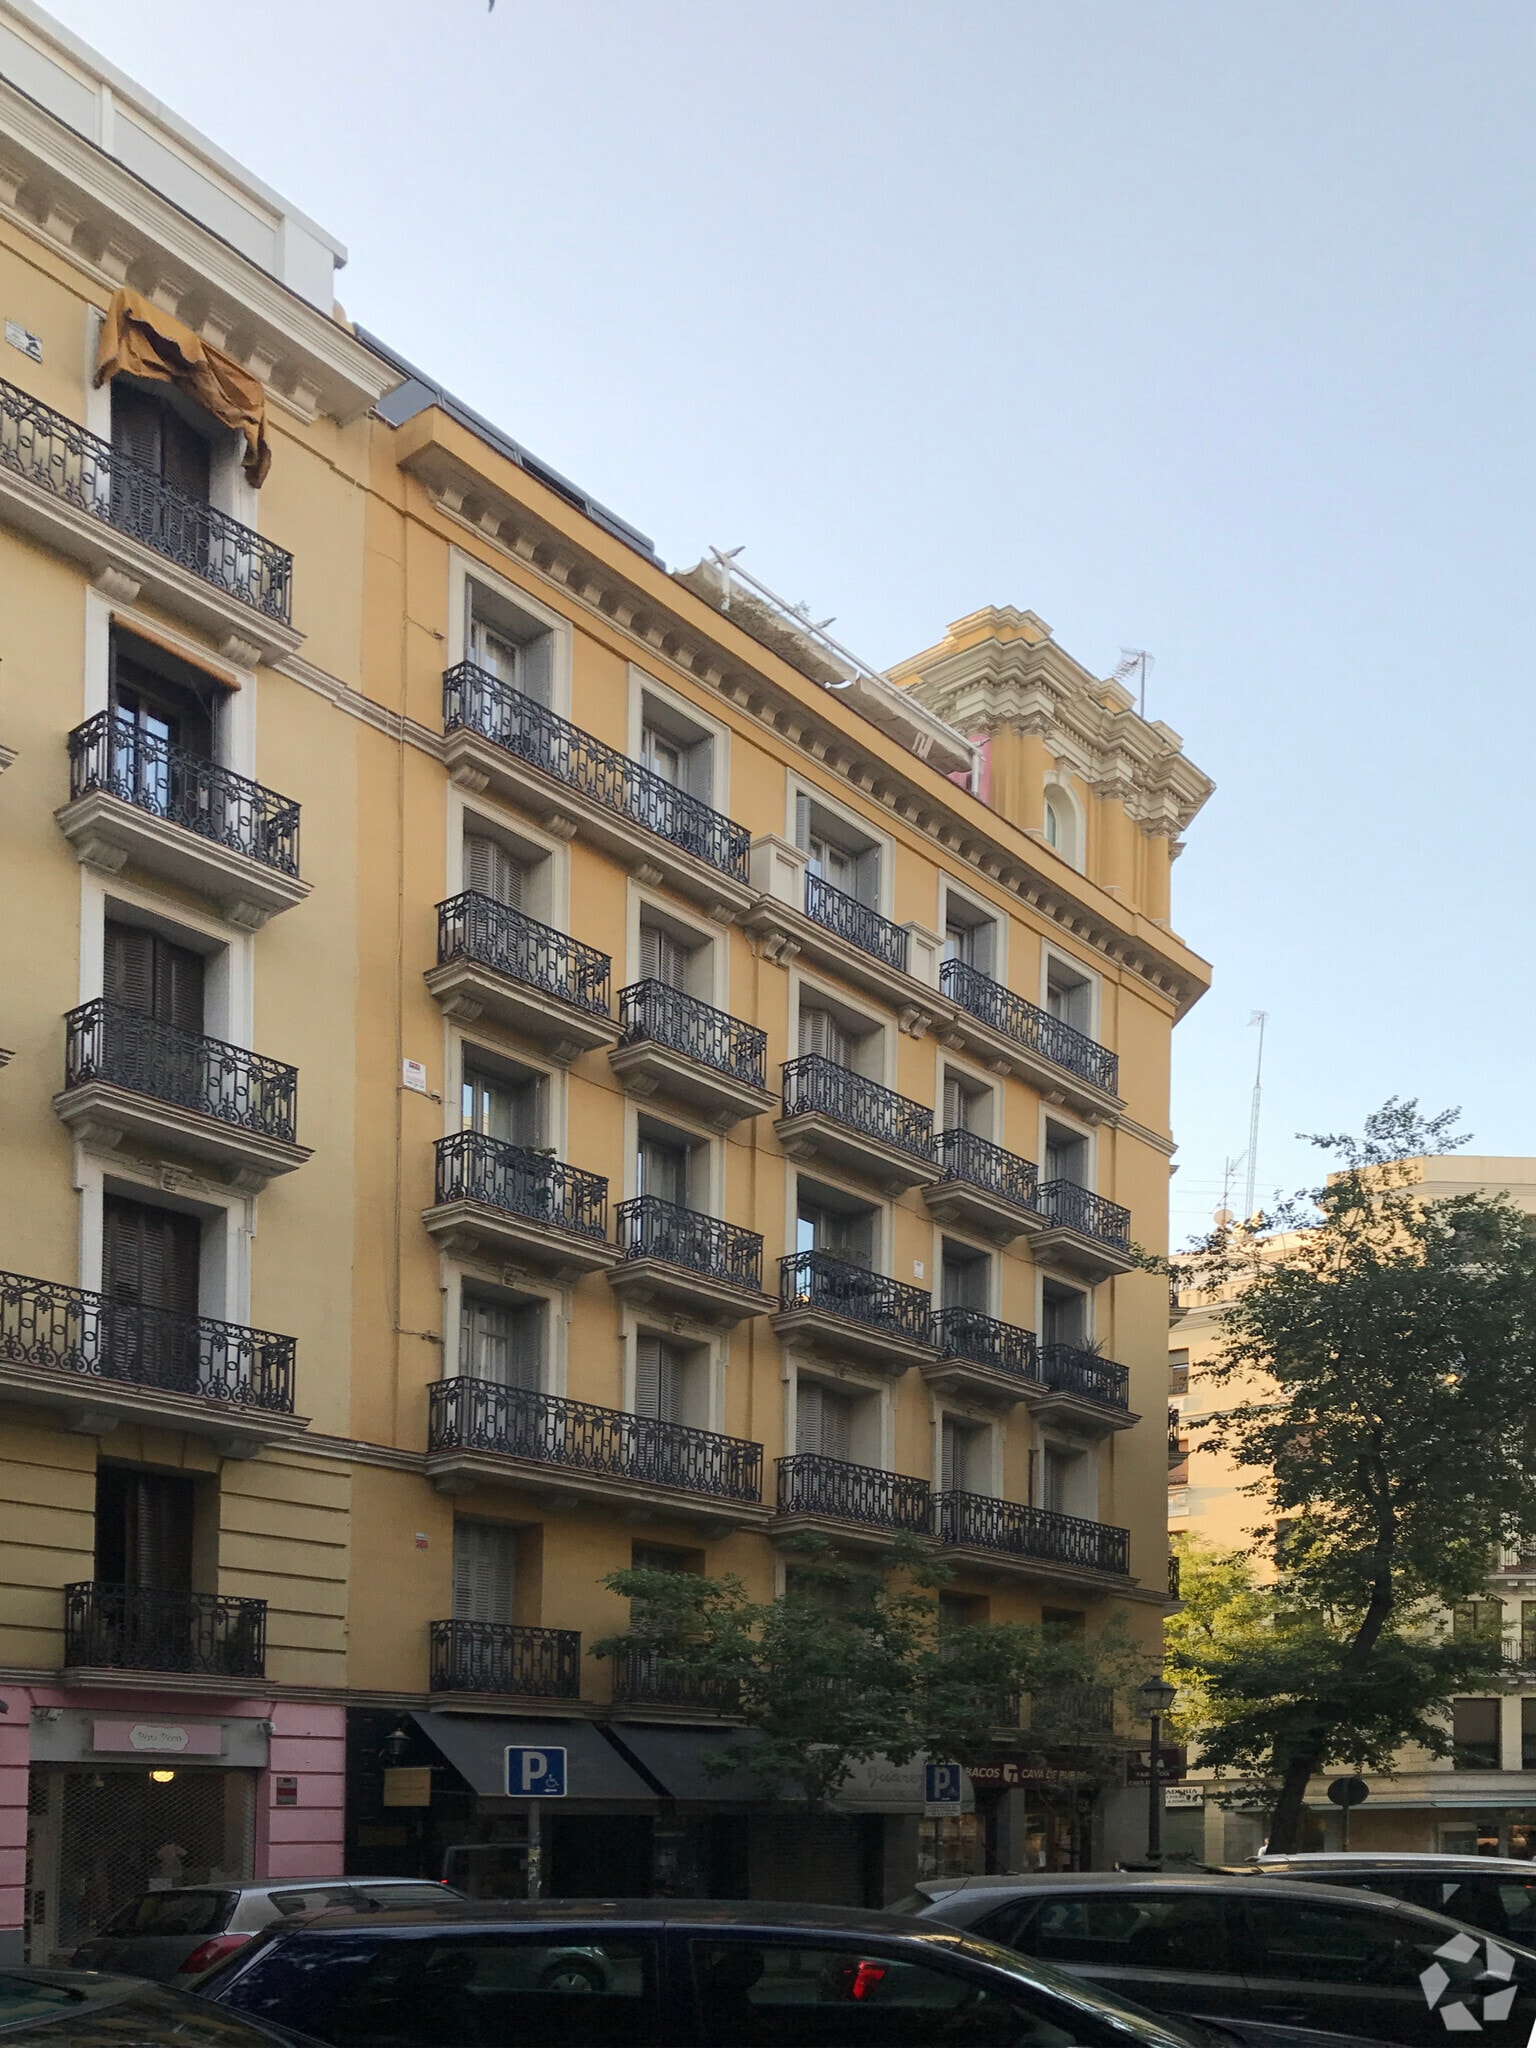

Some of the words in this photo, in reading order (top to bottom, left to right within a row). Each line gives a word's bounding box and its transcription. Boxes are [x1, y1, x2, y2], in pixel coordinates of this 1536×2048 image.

[522, 1751, 547, 1790] P
[934, 1766, 950, 1798] P
[966, 1767, 1000, 1778] BACOS
